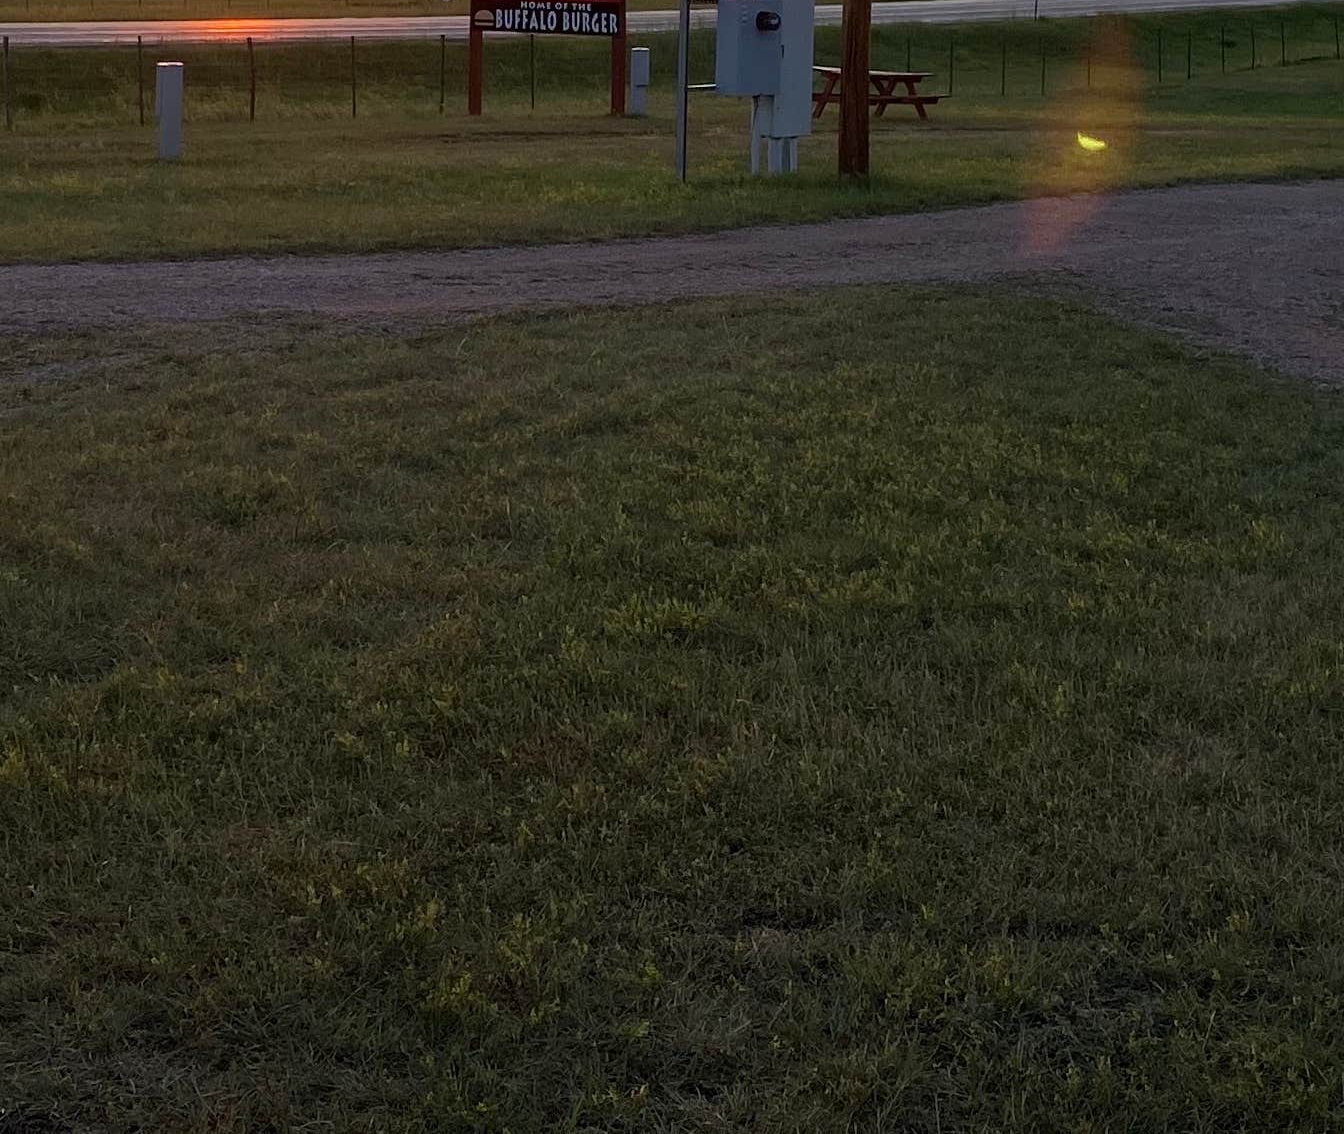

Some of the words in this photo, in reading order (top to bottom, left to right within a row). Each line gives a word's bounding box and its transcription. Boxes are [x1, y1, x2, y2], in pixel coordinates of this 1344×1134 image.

[520, 1, 551, 10] HOME
[555, 2, 568, 10] OF
[572, 3, 592, 11] THE
[495, 9, 556, 31] BUFFALO
[563, 11, 618, 34] BURGER
